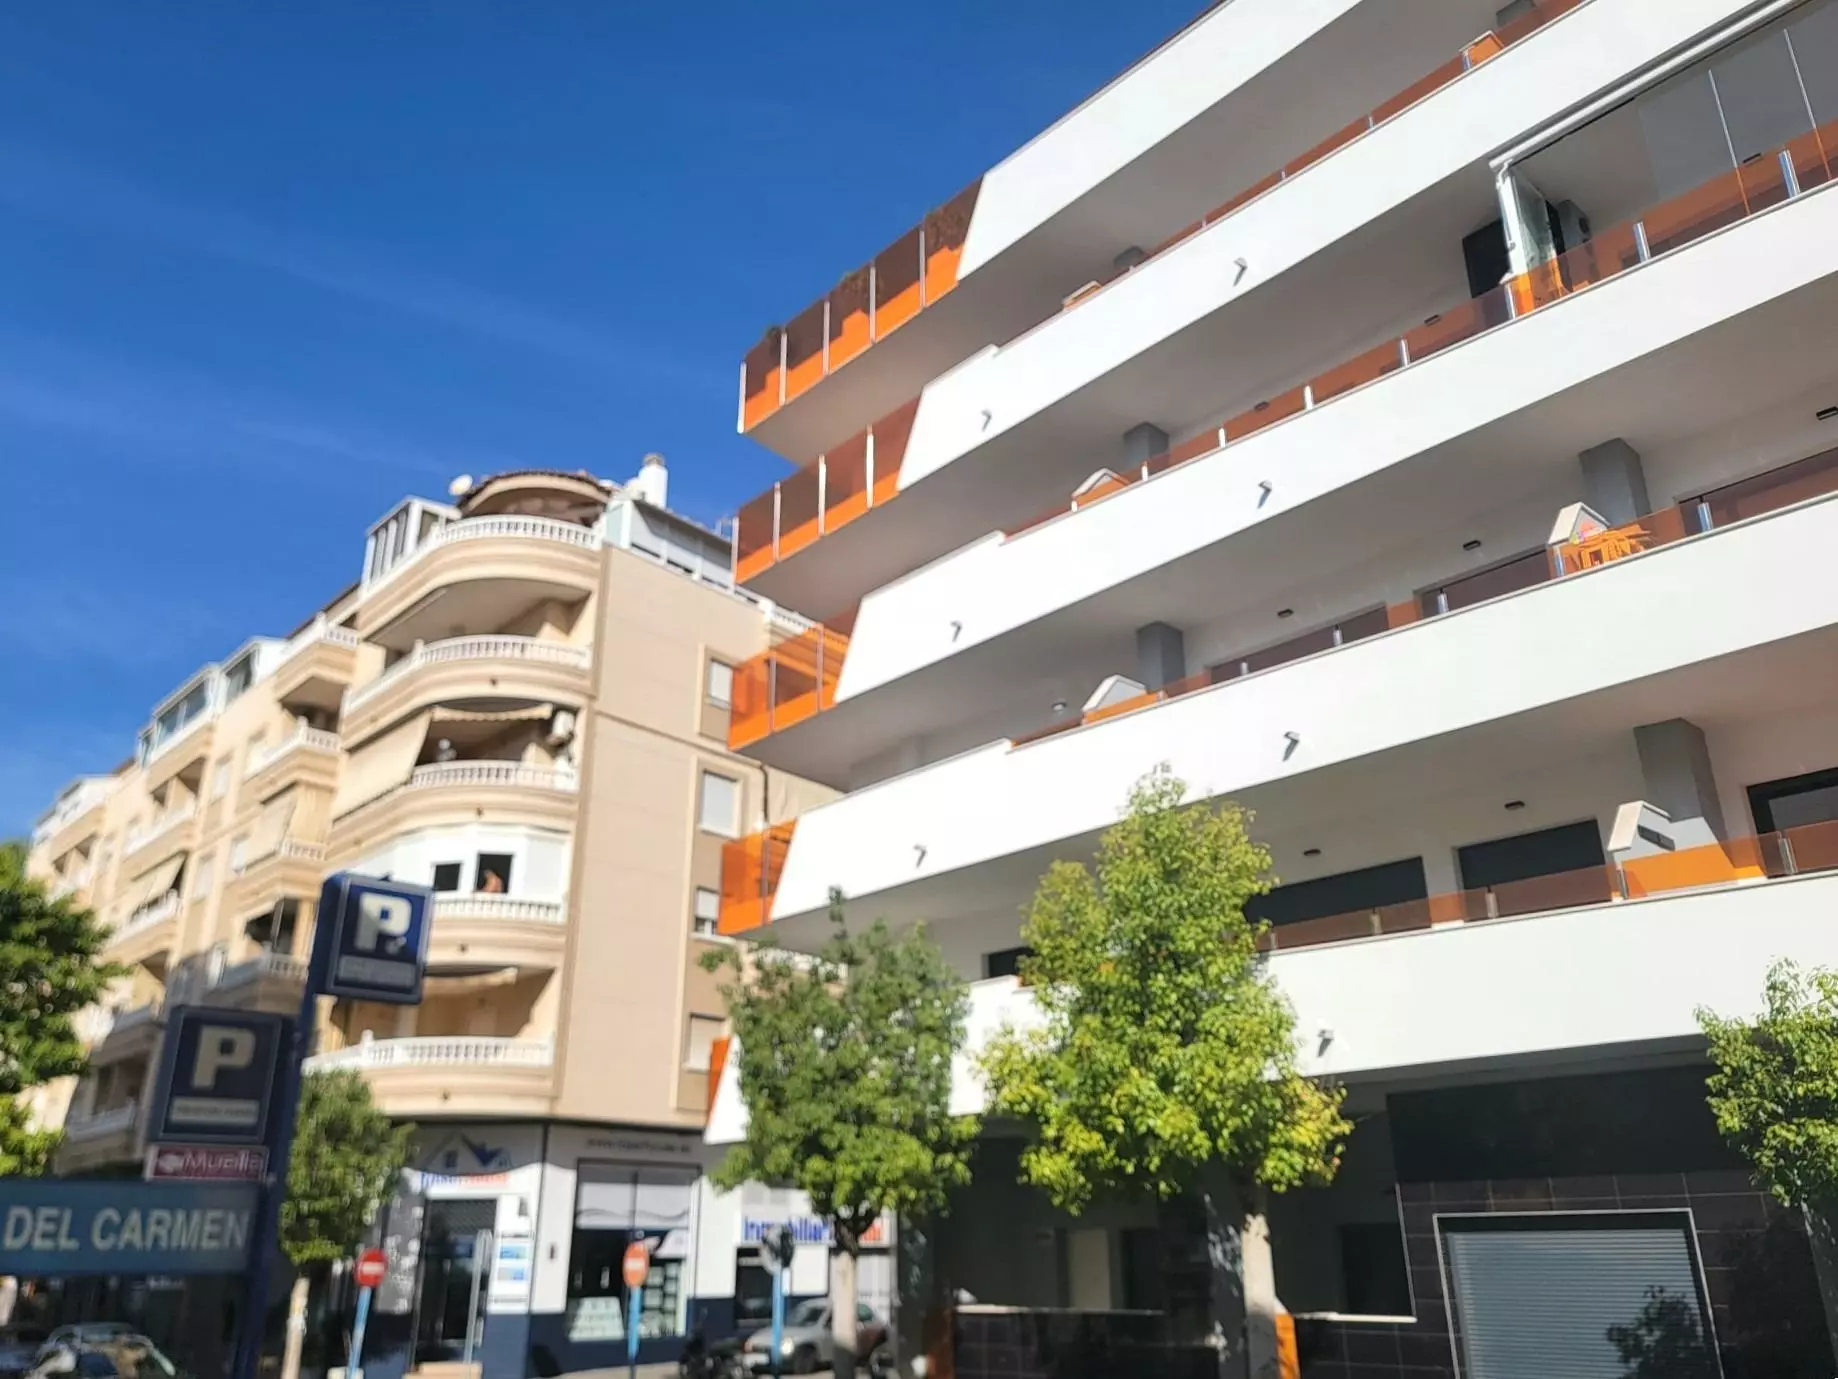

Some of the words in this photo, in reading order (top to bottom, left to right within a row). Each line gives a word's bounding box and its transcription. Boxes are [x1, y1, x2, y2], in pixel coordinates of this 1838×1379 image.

[355, 891, 412, 953] P
[192, 1025, 256, 1089] P
[4, 1205, 80, 1250] DEL
[91, 1206, 250, 1250] CARMEN
